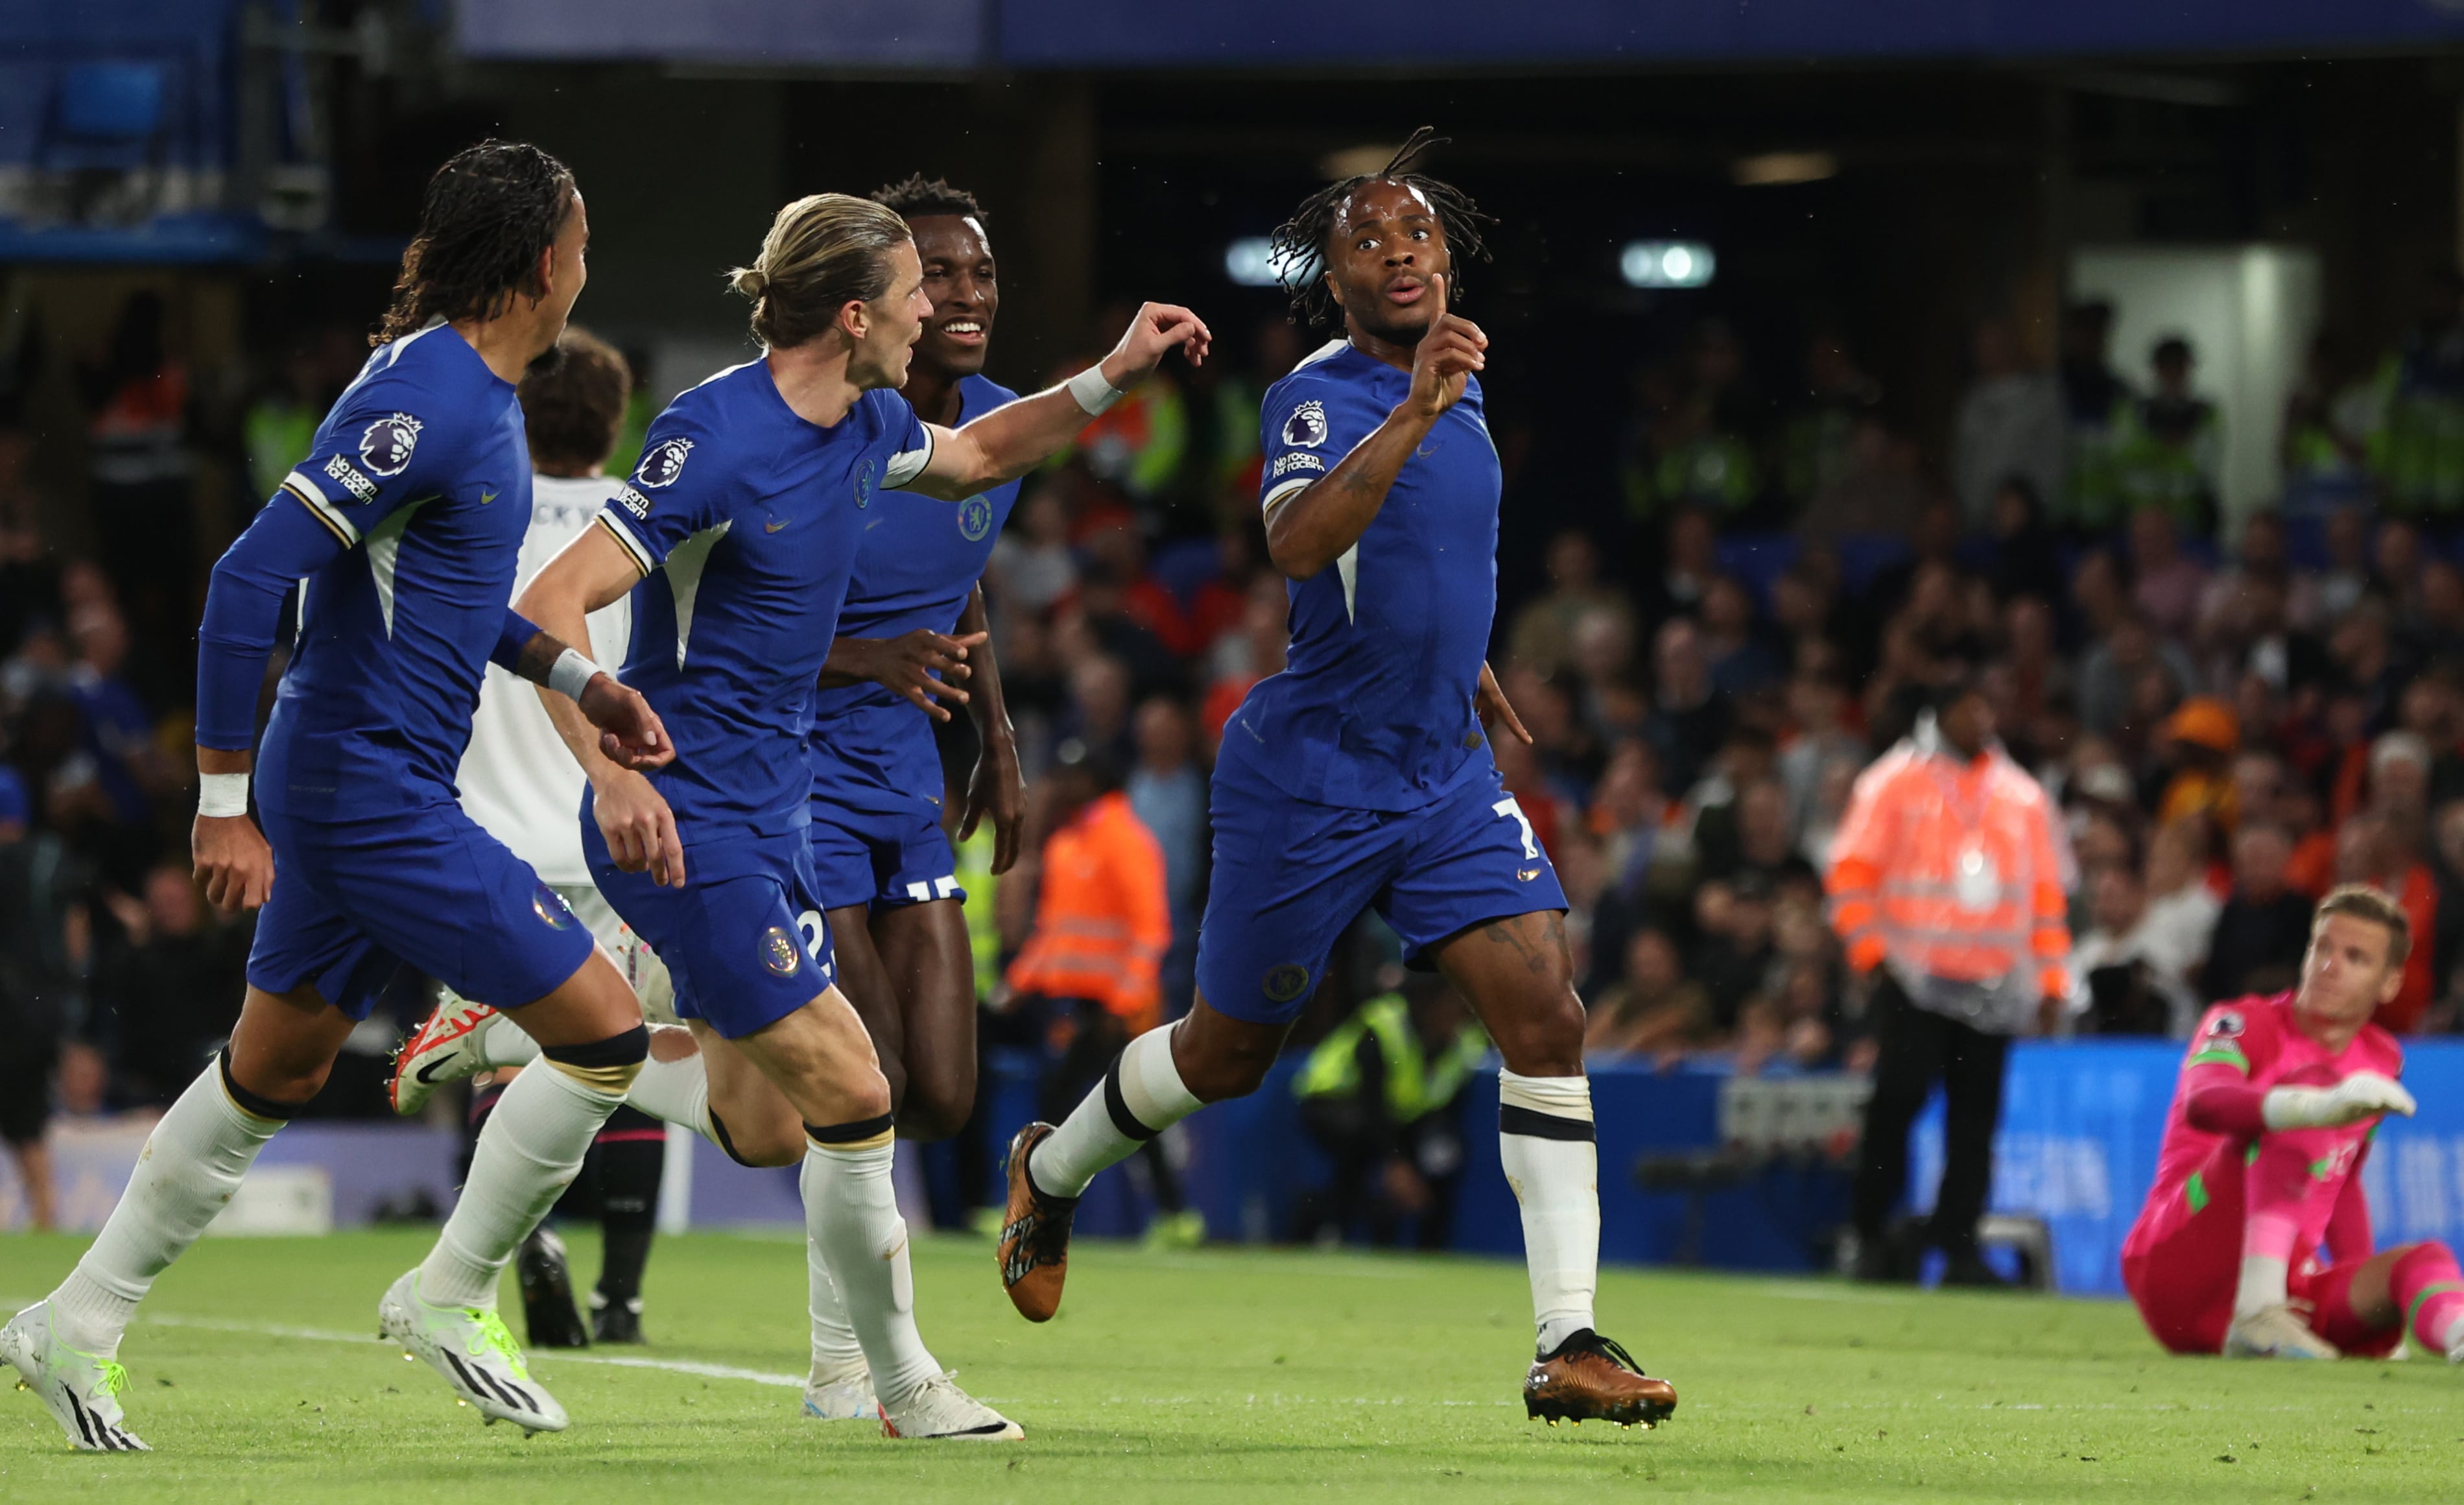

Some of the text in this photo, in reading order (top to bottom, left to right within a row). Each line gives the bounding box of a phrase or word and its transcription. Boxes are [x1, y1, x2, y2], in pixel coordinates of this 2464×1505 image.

[329, 453, 377, 495] No room
[1273, 460, 1325, 479] for racism
[1274, 452, 1319, 468] No room
[324, 463, 373, 504] for racism
[1491, 797, 1539, 860] 7
